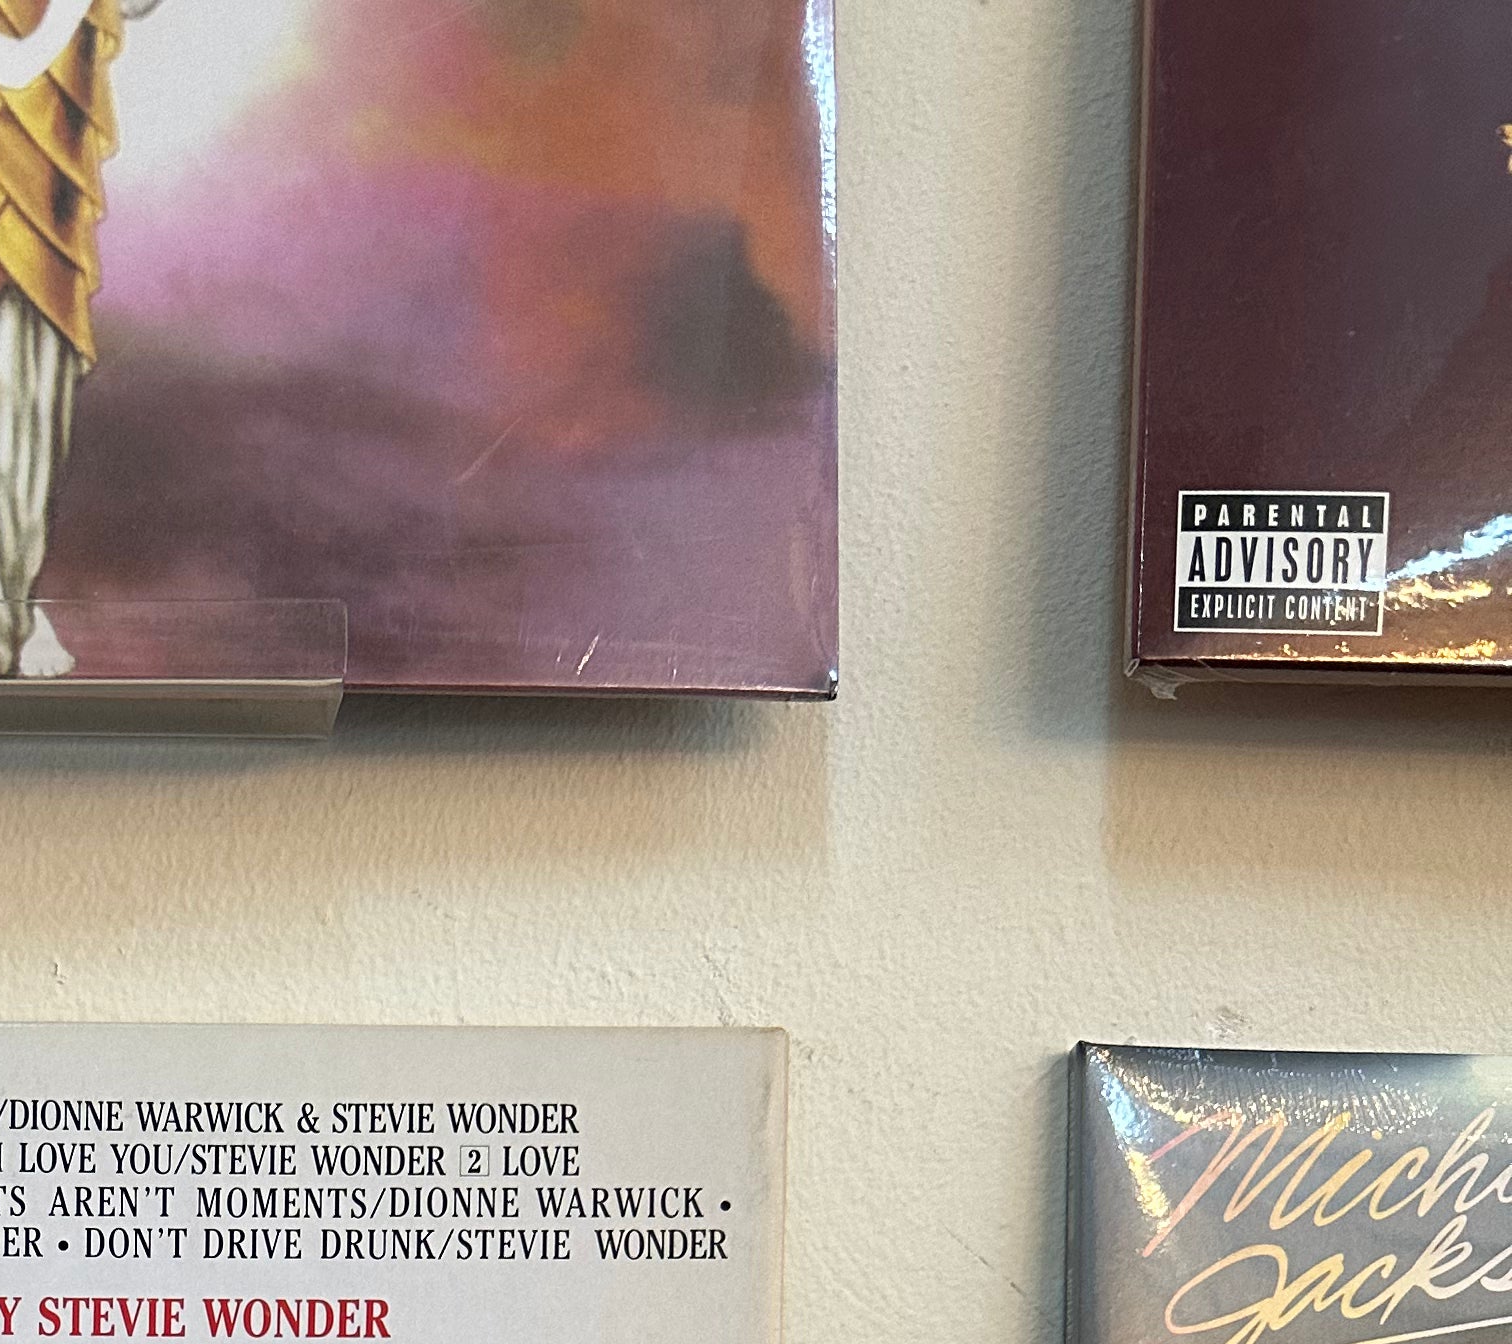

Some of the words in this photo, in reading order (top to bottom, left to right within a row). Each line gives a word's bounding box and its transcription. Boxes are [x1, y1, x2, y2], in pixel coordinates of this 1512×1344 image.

[1194, 503, 1372, 529] PARENTAL
[1187, 535, 1375, 584] ADVISORY
[1191, 594, 1275, 620] EXPLICIT
[1286, 595, 1367, 622] CONTENT
[135, 1102, 284, 1133] WARWICK
[298, 1103, 320, 1133] &
[333, 1103, 434, 1133] STEVIE
[447, 1103, 579, 1133] WONDER
[19, 1143, 95, 1173] LOVE
[110, 1144, 296, 1175] YOU/STEVIE
[311, 1146, 446, 1176] WONDER
[503, 1146, 579, 1176] LOVE
[49, 1187, 174, 1217] AREN'T
[197, 1187, 518, 1218] MOMENTS/DIONNE
[536, 1187, 703, 1218] WARWICK
[85, 1228, 187, 1258] DON'T
[204, 1229, 301, 1259] DRIVE
[321, 1229, 570, 1259] DRUNK/STEVIE
[595, 1229, 728, 1260] WONDER
[39, 1298, 184, 1336] STEVIE
[205, 1299, 388, 1337] WONDER
